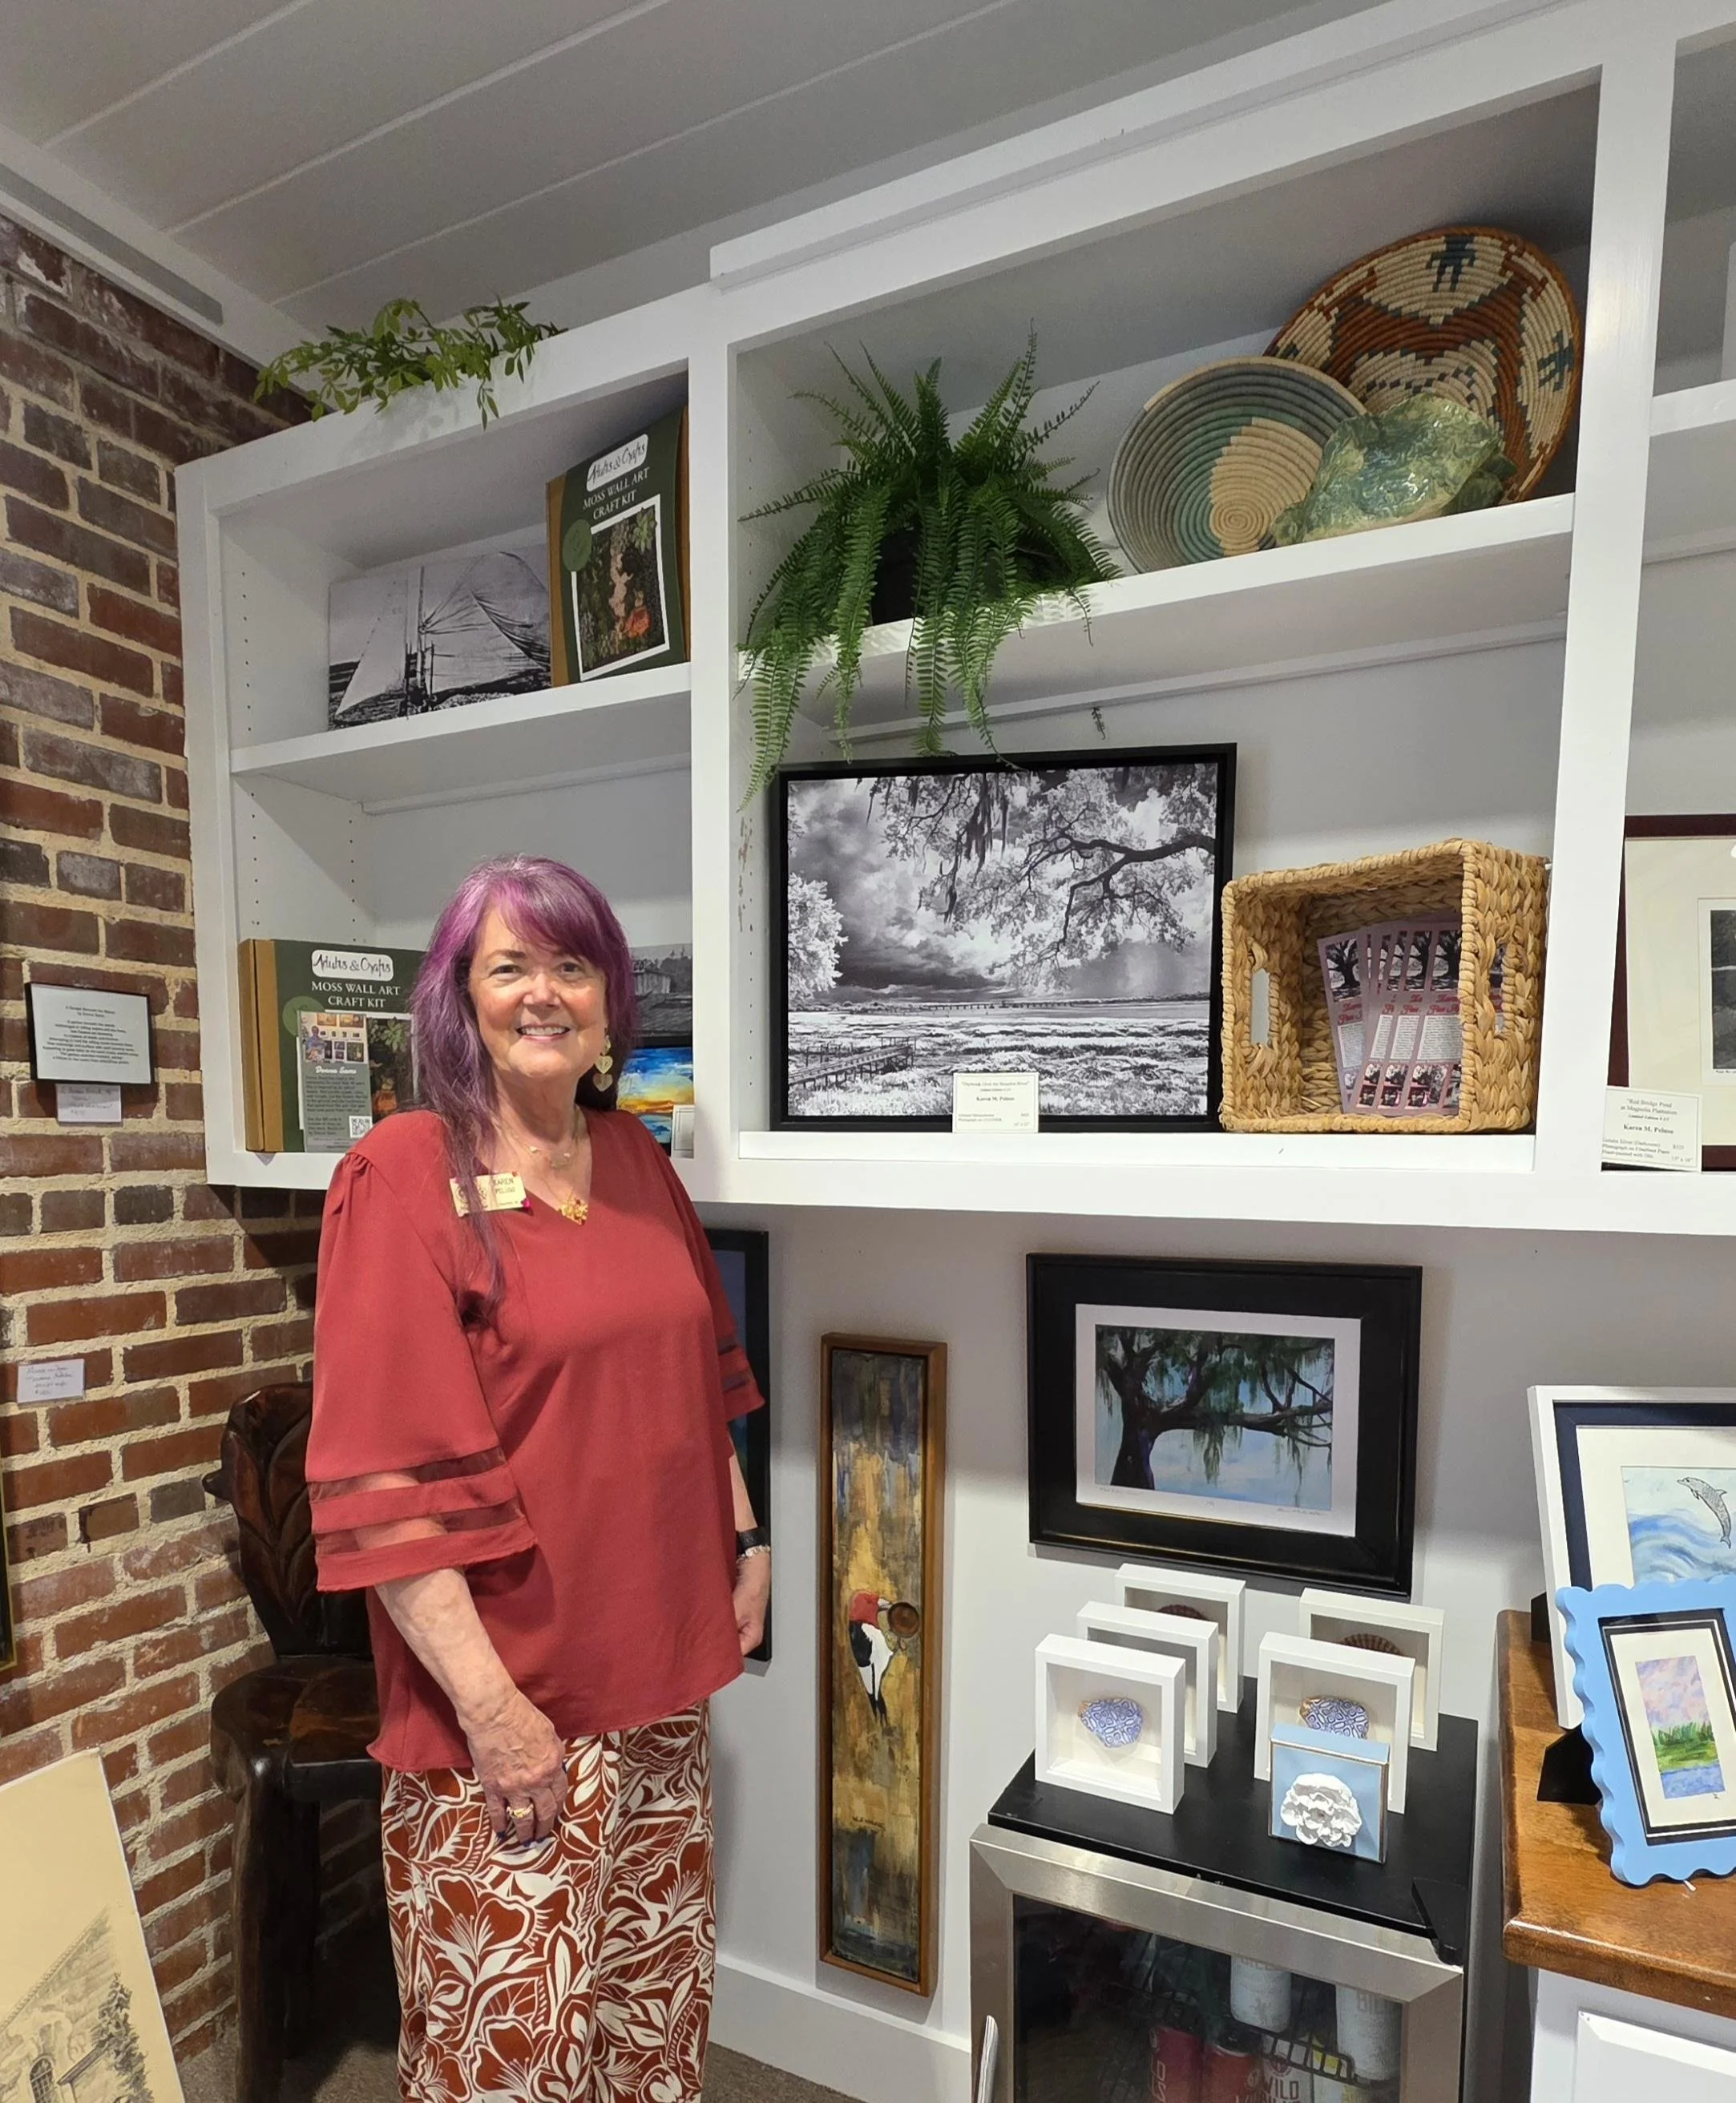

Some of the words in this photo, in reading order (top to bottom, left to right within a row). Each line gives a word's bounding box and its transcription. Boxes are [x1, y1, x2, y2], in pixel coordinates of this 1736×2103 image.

[621, 442, 645, 464] Crafts
[583, 490, 606, 510] MOSS
[608, 478, 630, 496] WALL
[632, 466, 650, 485] ART
[593, 497, 621, 519] CRAFT
[621, 489, 636, 506] KIT
[313, 953, 348, 973] Adults
[349, 960, 359, 971] &
[361, 957, 391, 977] Crafts
[311, 981, 343, 992] MOSS
[345, 983, 375, 994] WALL
[378, 985, 401, 995] ART
[328, 995, 365, 1007] CRAFT
[367, 998, 386, 1007] KIT
